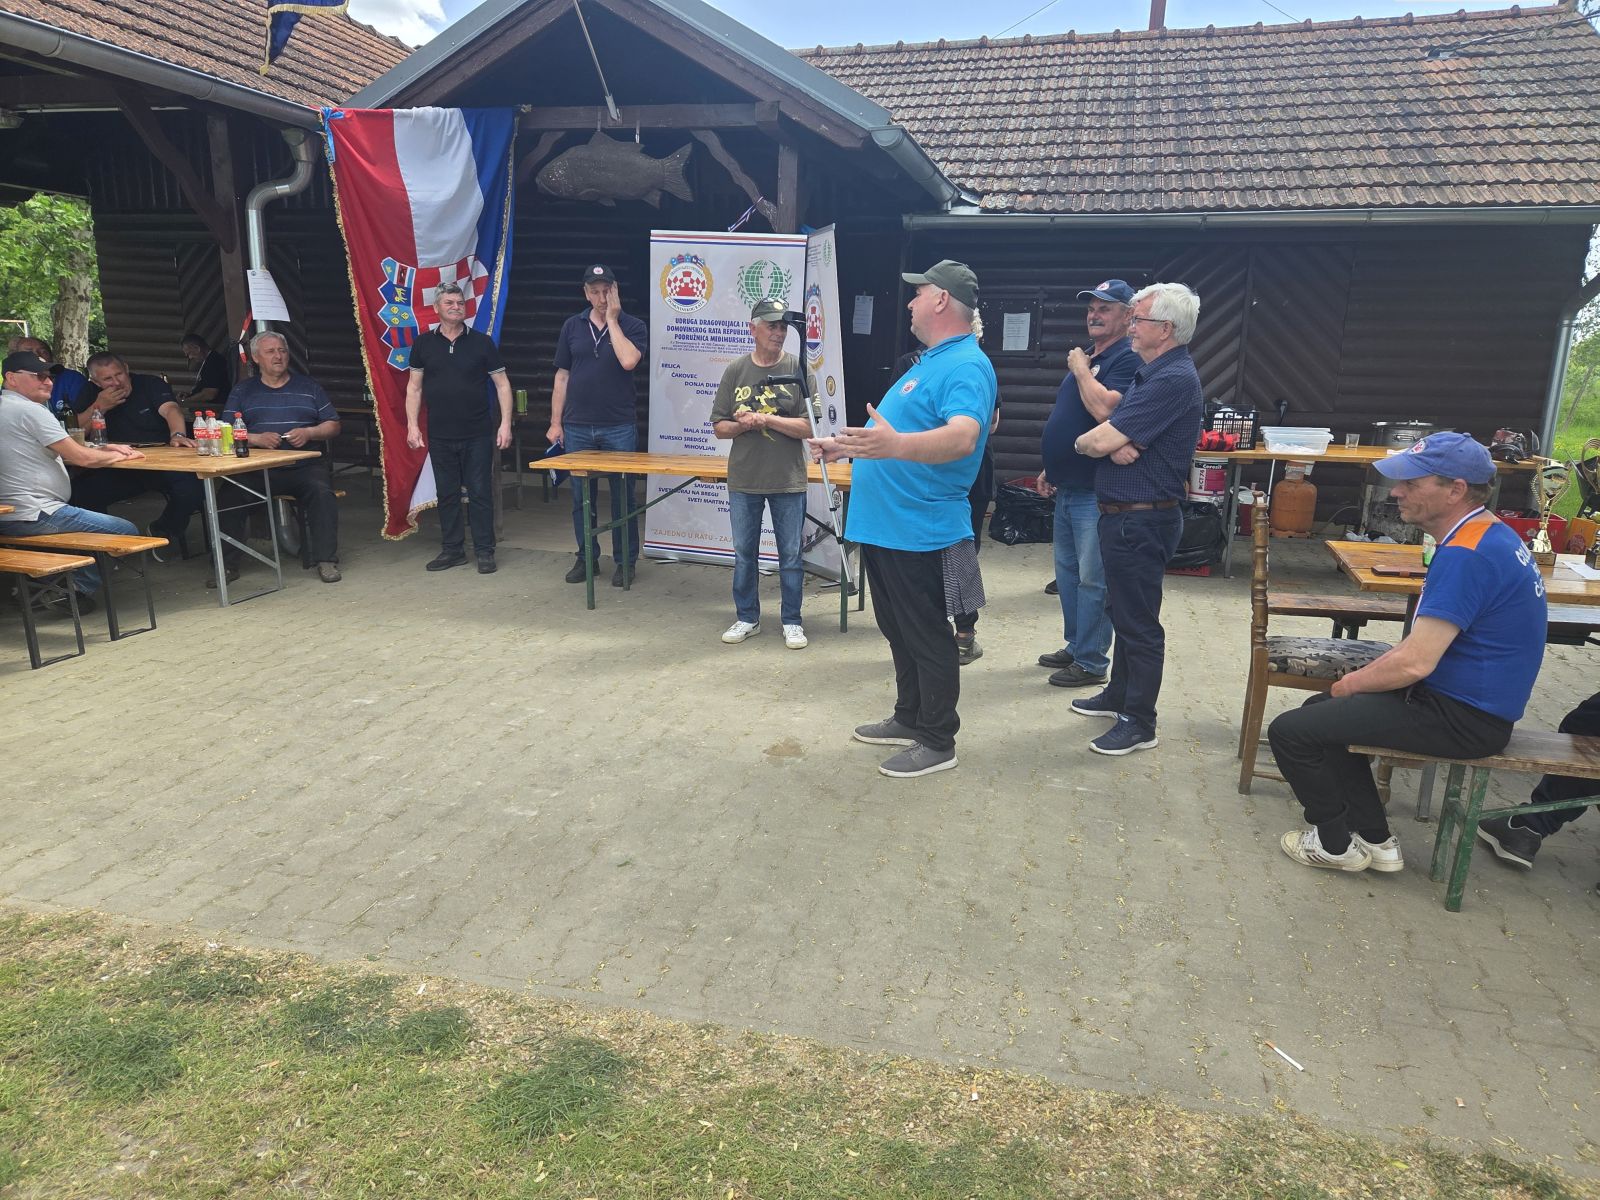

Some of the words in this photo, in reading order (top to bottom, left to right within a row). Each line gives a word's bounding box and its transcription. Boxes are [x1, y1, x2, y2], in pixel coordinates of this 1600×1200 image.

[675, 317, 698, 325] UDRUGA
[699, 319, 740, 329] DRAGOVOLJACA
[666, 325, 707, 334] DOMOVINSKOG
[684, 443, 716, 451] MIHOVLJAN
[694, 532, 713, 541] RATU
